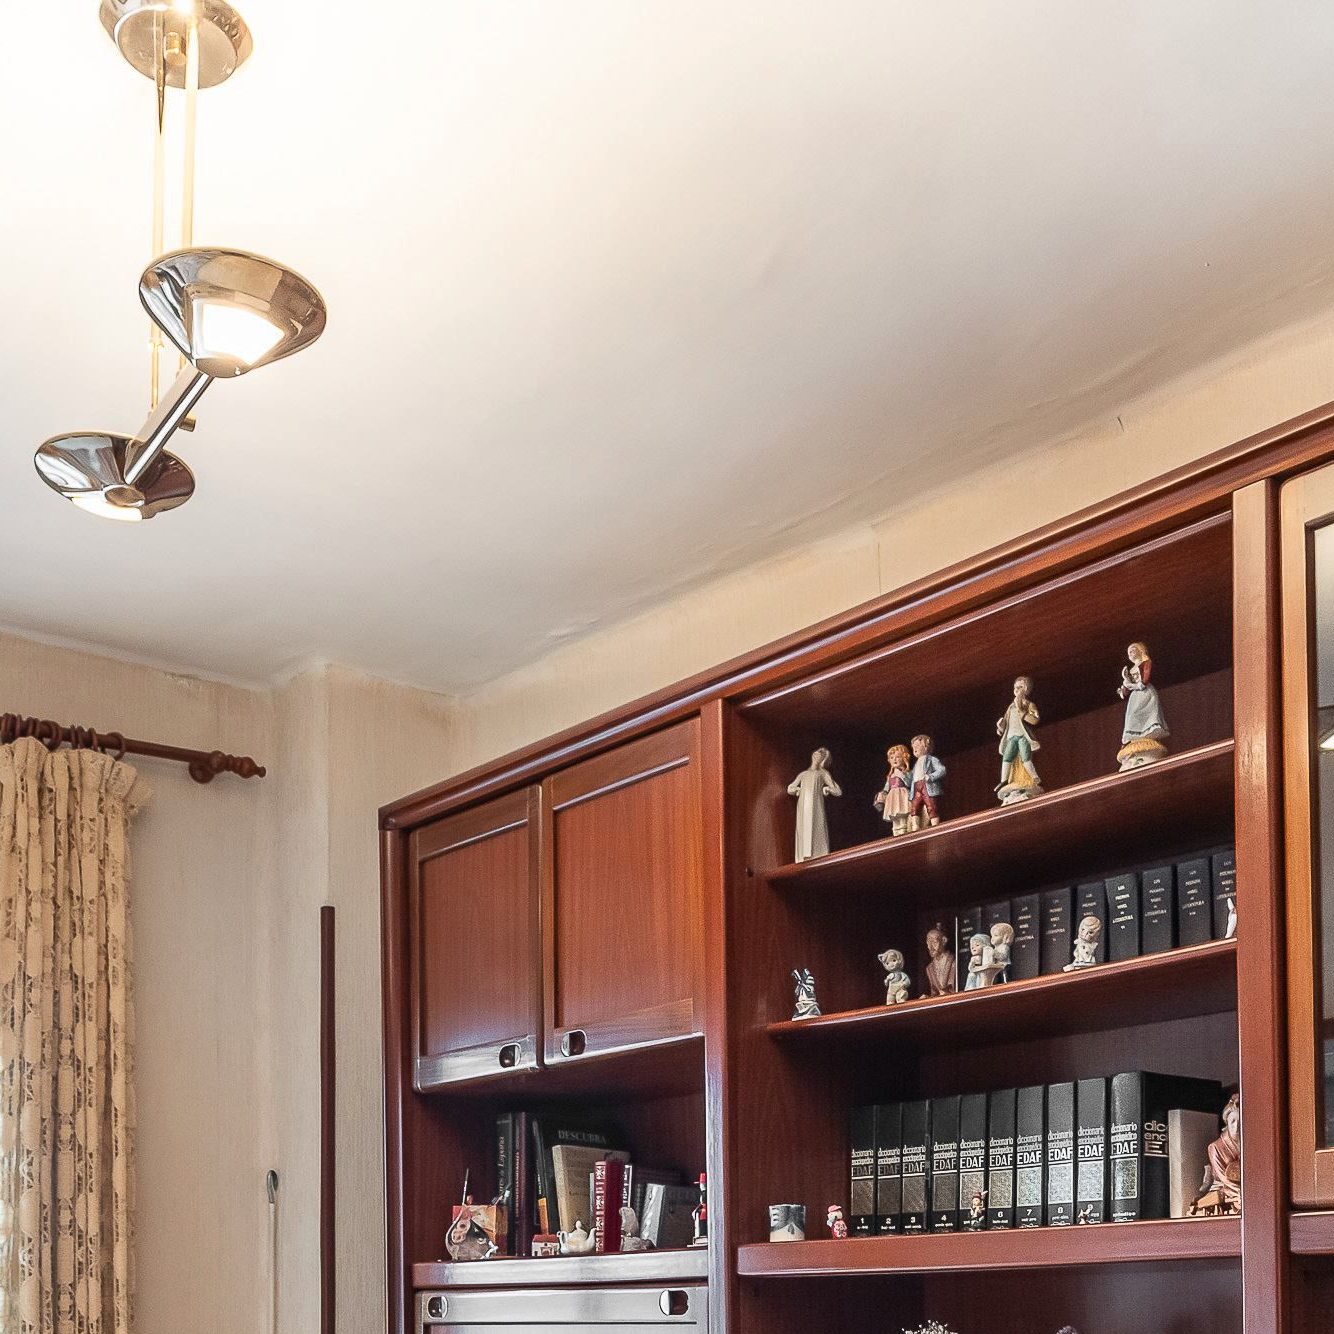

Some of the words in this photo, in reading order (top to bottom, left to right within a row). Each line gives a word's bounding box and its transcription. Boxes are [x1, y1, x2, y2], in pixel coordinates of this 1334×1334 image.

[1048, 1147, 1073, 1160] EDAF
[1078, 1144, 1104, 1157] EDAF
[1111, 1141, 1138, 1154] EDAF
[960, 1156, 984, 1168] EDAF
[990, 1154, 1013, 1166] EDAF
[1017, 1151, 1042, 1164] EDAF
[878, 1163, 900, 1175] EDAF
[903, 1161, 925, 1173] EDAF
[934, 1158, 957, 1170] EDAF
[851, 1165, 873, 1176] EDAF
